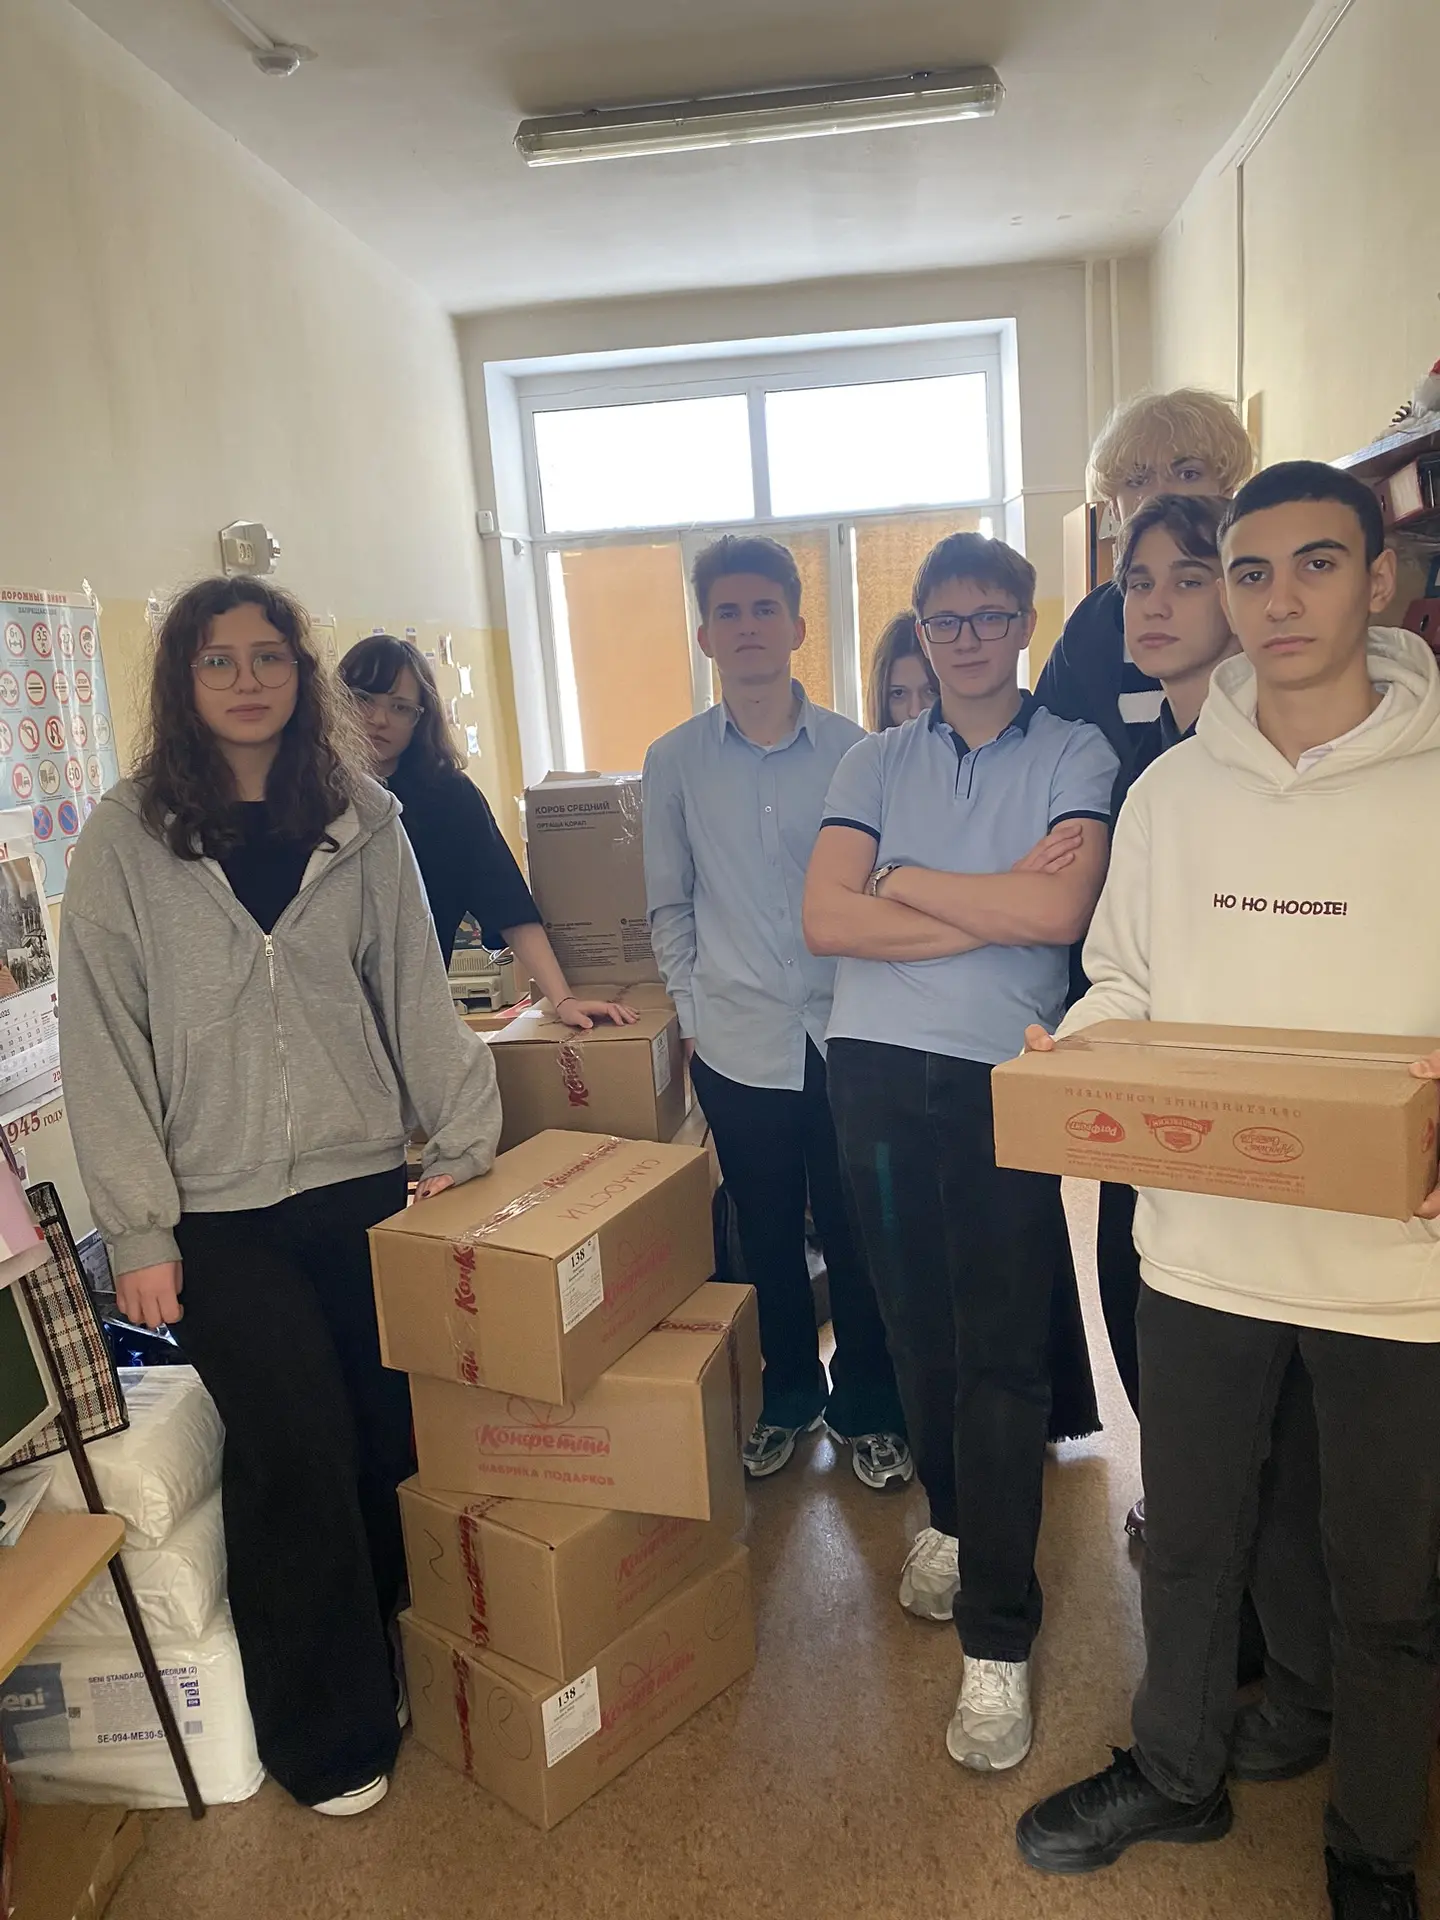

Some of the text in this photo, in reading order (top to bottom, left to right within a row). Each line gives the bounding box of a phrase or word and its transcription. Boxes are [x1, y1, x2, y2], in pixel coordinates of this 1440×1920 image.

[1, 590, 44, 602] ДОРОЖНЫЕ
[535, 805, 565, 815] КОРОБ
[566, 800, 610, 812] СРЕДНИЙ
[1213, 893, 1347, 916] HO HO HOODIE!
[7, 1109, 63, 1144] 945 году
[556, 1158, 661, 1220] СЛАДОСТИ
[571, 1247, 585, 1268] 138
[479, 1424, 611, 1455] Конфетти
[478, 1462, 615, 1486] ФАБРИКА ПОДАРКОВ
[106, 1671, 145, 1682] STANDARD
[158, 1667, 187, 1677] MEDIUM
[188, 1666, 198, 1675] (2)
[0, 1687, 45, 1712] eni
[557, 1686, 577, 1708] 138
